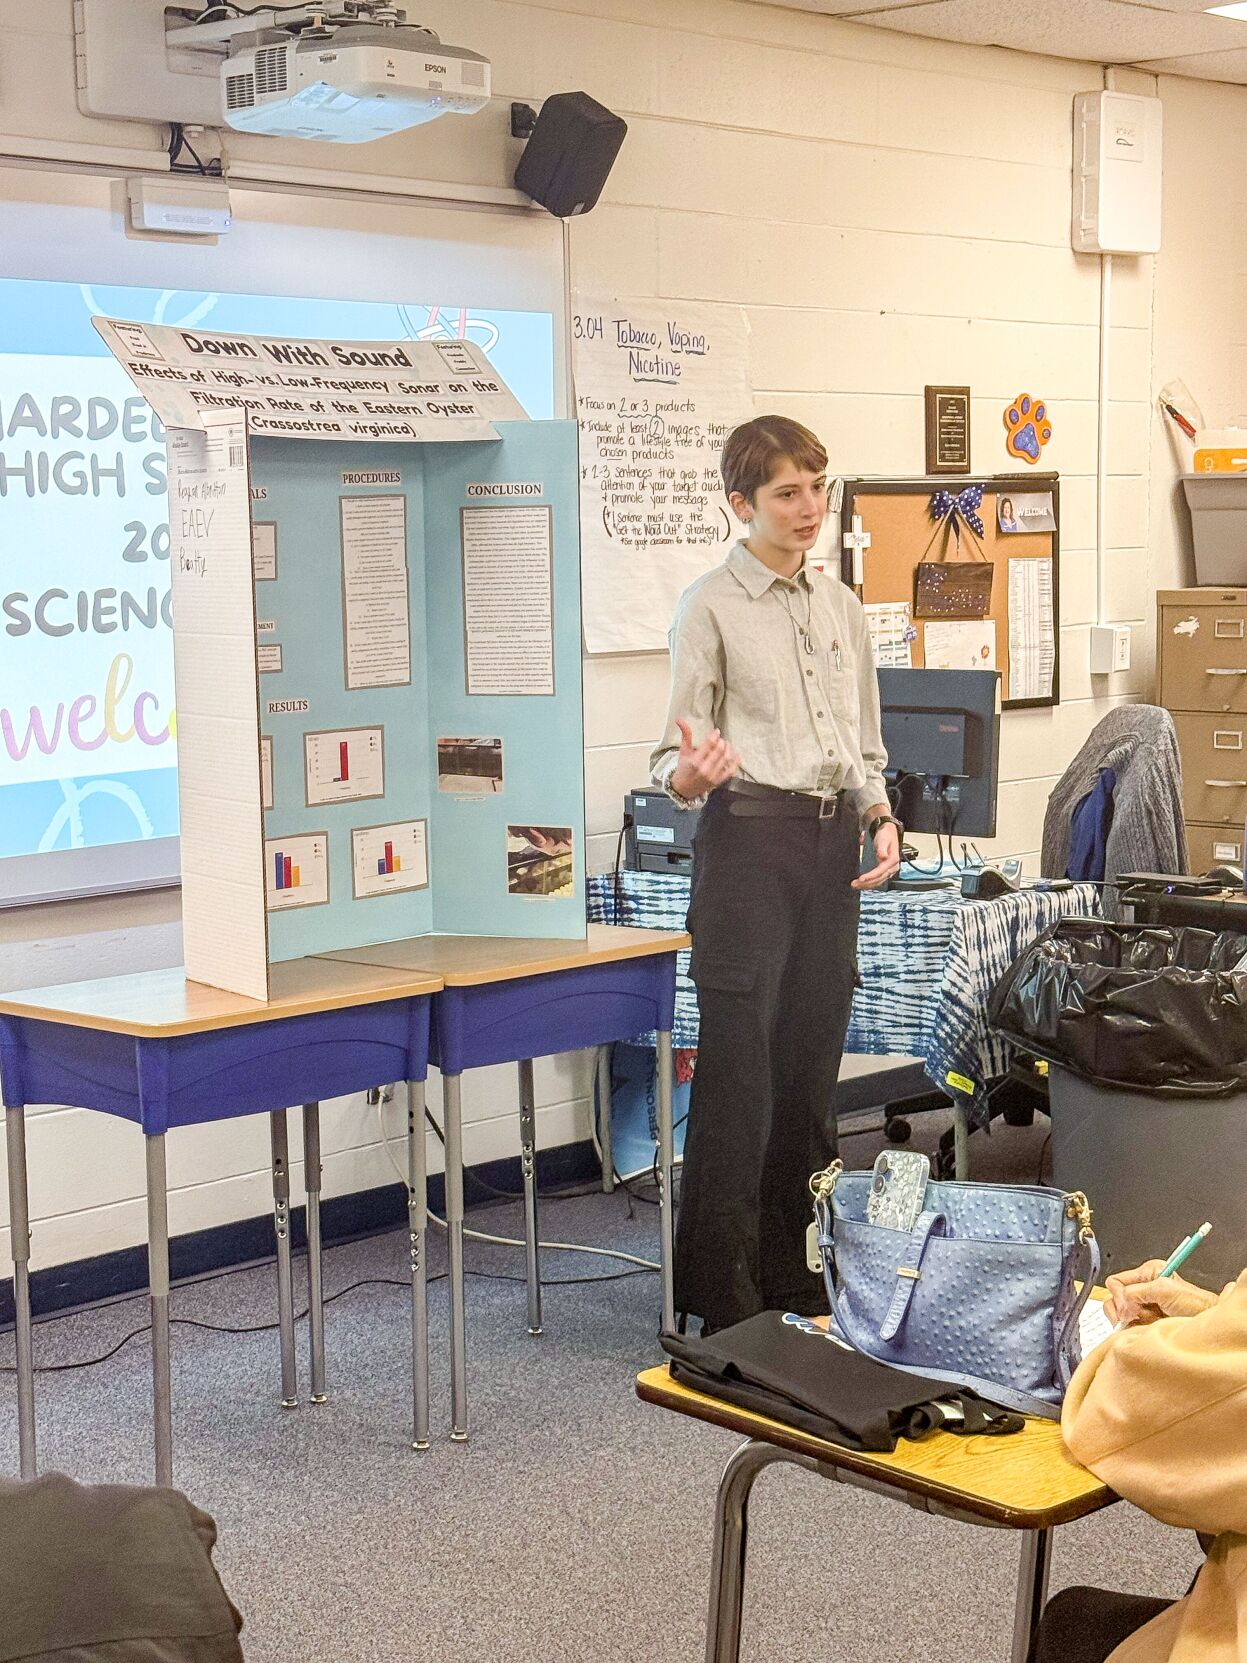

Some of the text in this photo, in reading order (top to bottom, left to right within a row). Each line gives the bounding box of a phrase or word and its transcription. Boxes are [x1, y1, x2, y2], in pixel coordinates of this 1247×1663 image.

[424, 63, 447, 74] EPSON
[573, 315, 603, 340] 3.04
[612, 319, 662, 349] Tobacco,
[180, 333, 413, 368] Down With Sound
[629, 350, 681, 377] Nicotine
[128, 362, 499, 394] Effects of High- vs. Low-Frequency Sonar on the
[189, 390, 476, 417] Filtration Rate of the Eastern Oyster
[585, 397, 605, 410] Focus
[619, 397, 628, 413] 2
[630, 402, 640, 412] or
[641, 399, 649, 412] 3
[655, 399, 696, 416] products
[0, 392, 166, 443] ARDE
[248, 415, 417, 438] (Crassostrea virginica)
[707, 422, 727, 435] that
[632, 447, 675, 463] products
[0, 450, 126, 498] HIGH
[343, 472, 401, 484] PROCEDURES
[658, 467, 676, 479] that
[703, 466, 718, 479] the
[468, 484, 541, 495] CONCLUSION
[672, 495, 708, 511] message
[689, 512, 704, 522] the
[1017, 507, 1048, 517] WELCOME
[122, 520, 171, 563] 20
[268, 700, 308, 713] RESULTS
